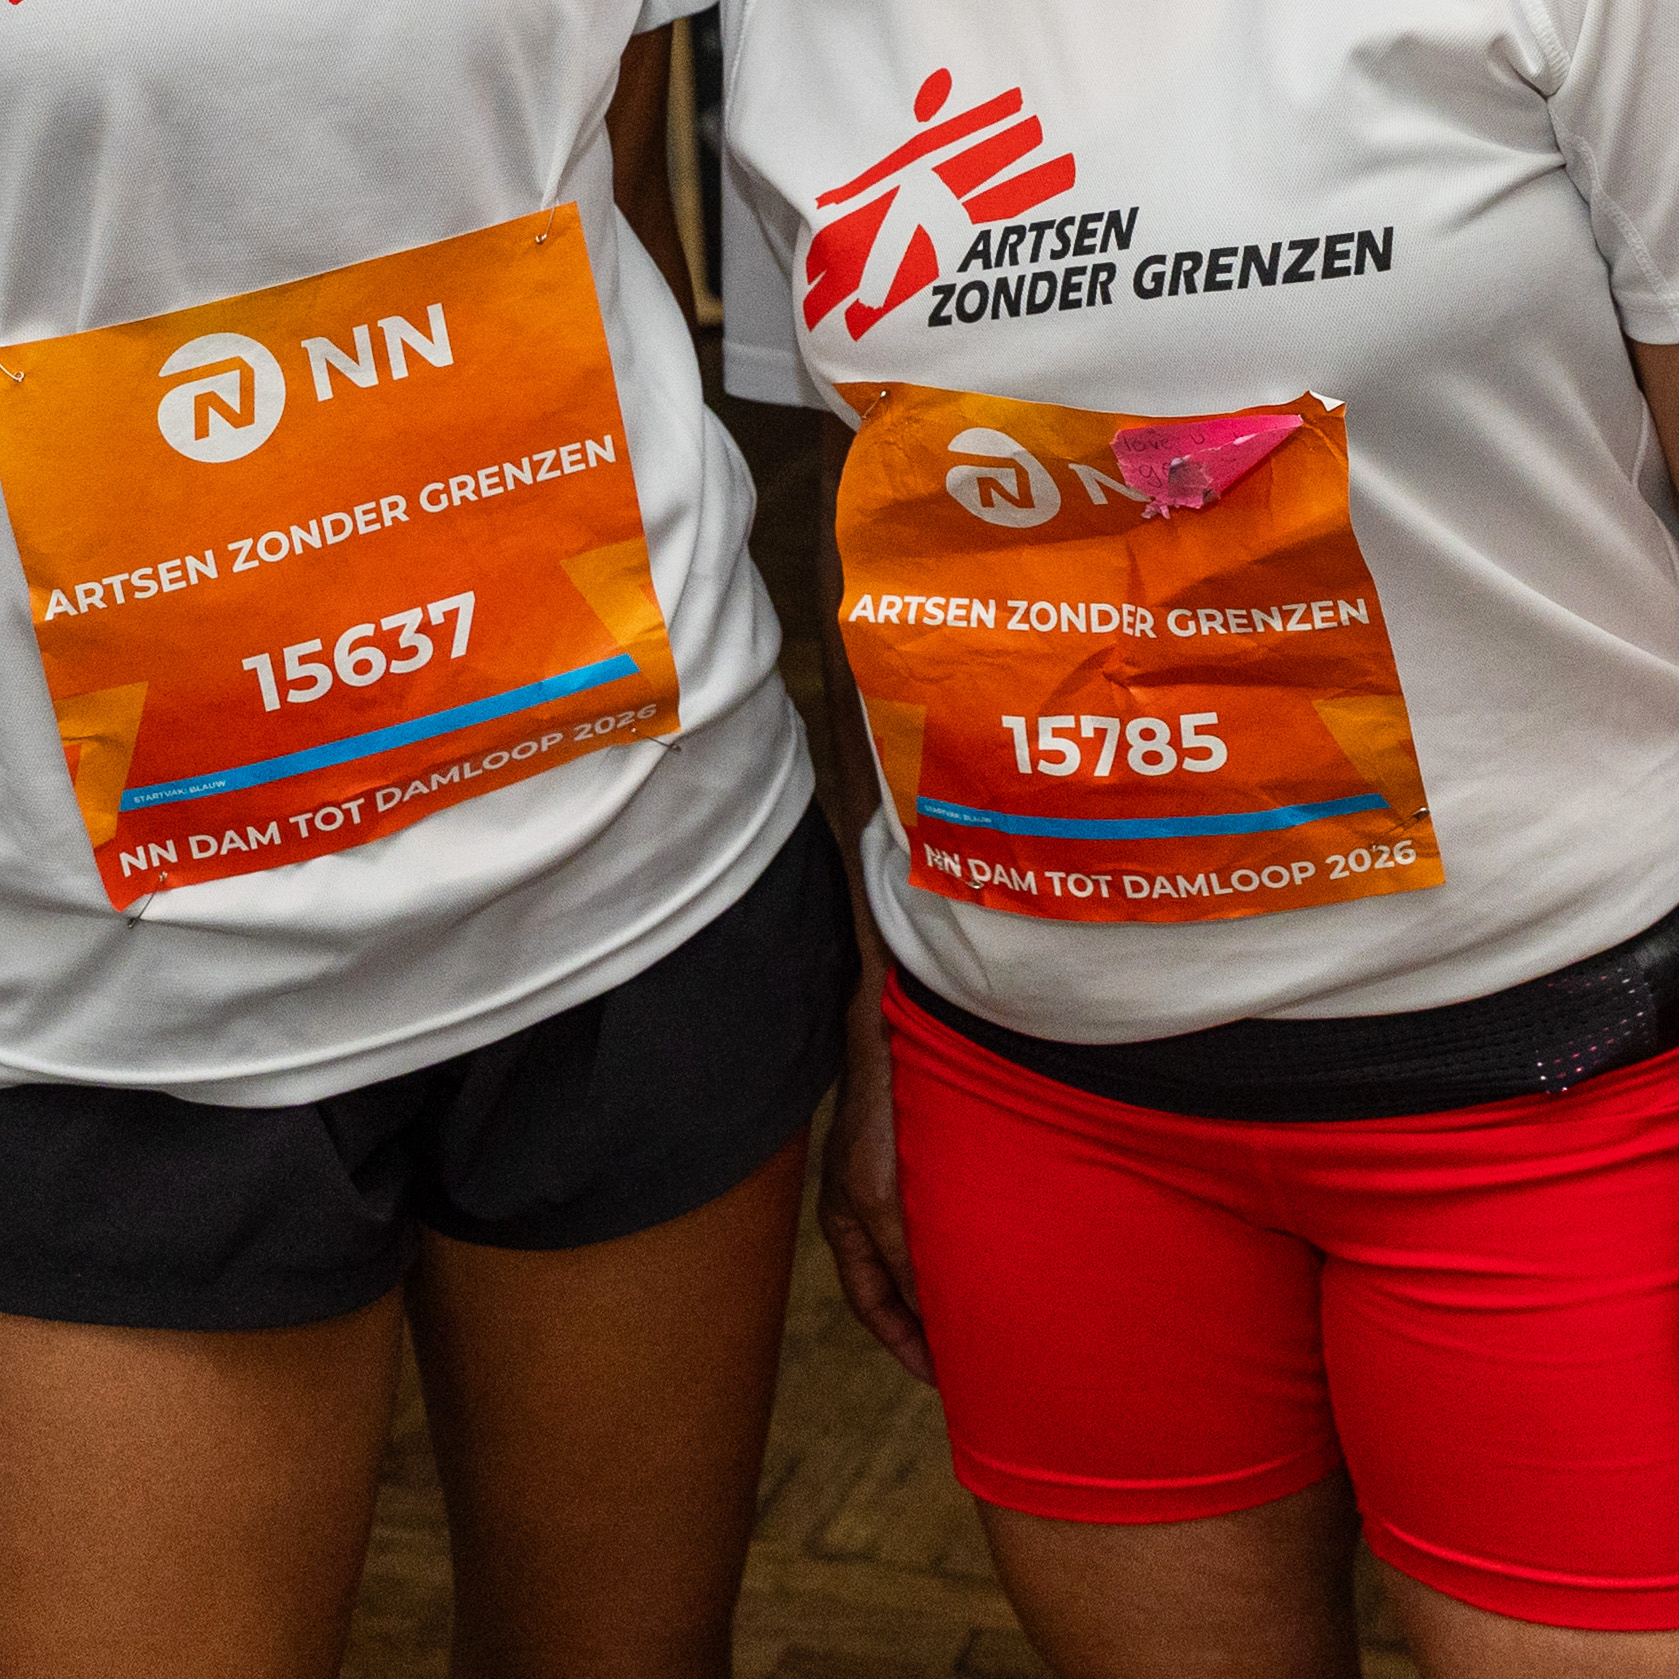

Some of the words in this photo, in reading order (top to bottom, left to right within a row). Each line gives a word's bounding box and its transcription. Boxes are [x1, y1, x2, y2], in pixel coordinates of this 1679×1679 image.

[928, 262, 1117, 327] ZONDER
[1133, 227, 1394, 299] GRENZEN
[957, 207, 1140, 273] ARTSEN
[301, 302, 456, 402] NN
[44, 549, 219, 621] ARTSEN
[228, 494, 409, 573] ZONDER
[419, 434, 617, 514] GRENZEN
[242, 591, 477, 712] 15637
[849, 594, 996, 628] ARTSEN
[1007, 601, 1157, 638] ZONDER
[1167, 598, 1370, 637] GRENZEN
[119, 839, 178, 878] NN
[189, 820, 282, 860] DAM
[289, 798, 362, 834] TOT
[375, 731, 564, 814] DAMLOOP
[573, 703, 658, 743] 2026
[1001, 711, 1229, 777] 15785
[923, 843, 963, 878] NN
[967, 858, 1038, 894] DAM
[1045, 871, 1112, 899] TOT
[1123, 861, 1316, 900] DAMLOOP
[1325, 840, 1417, 878] 2026
